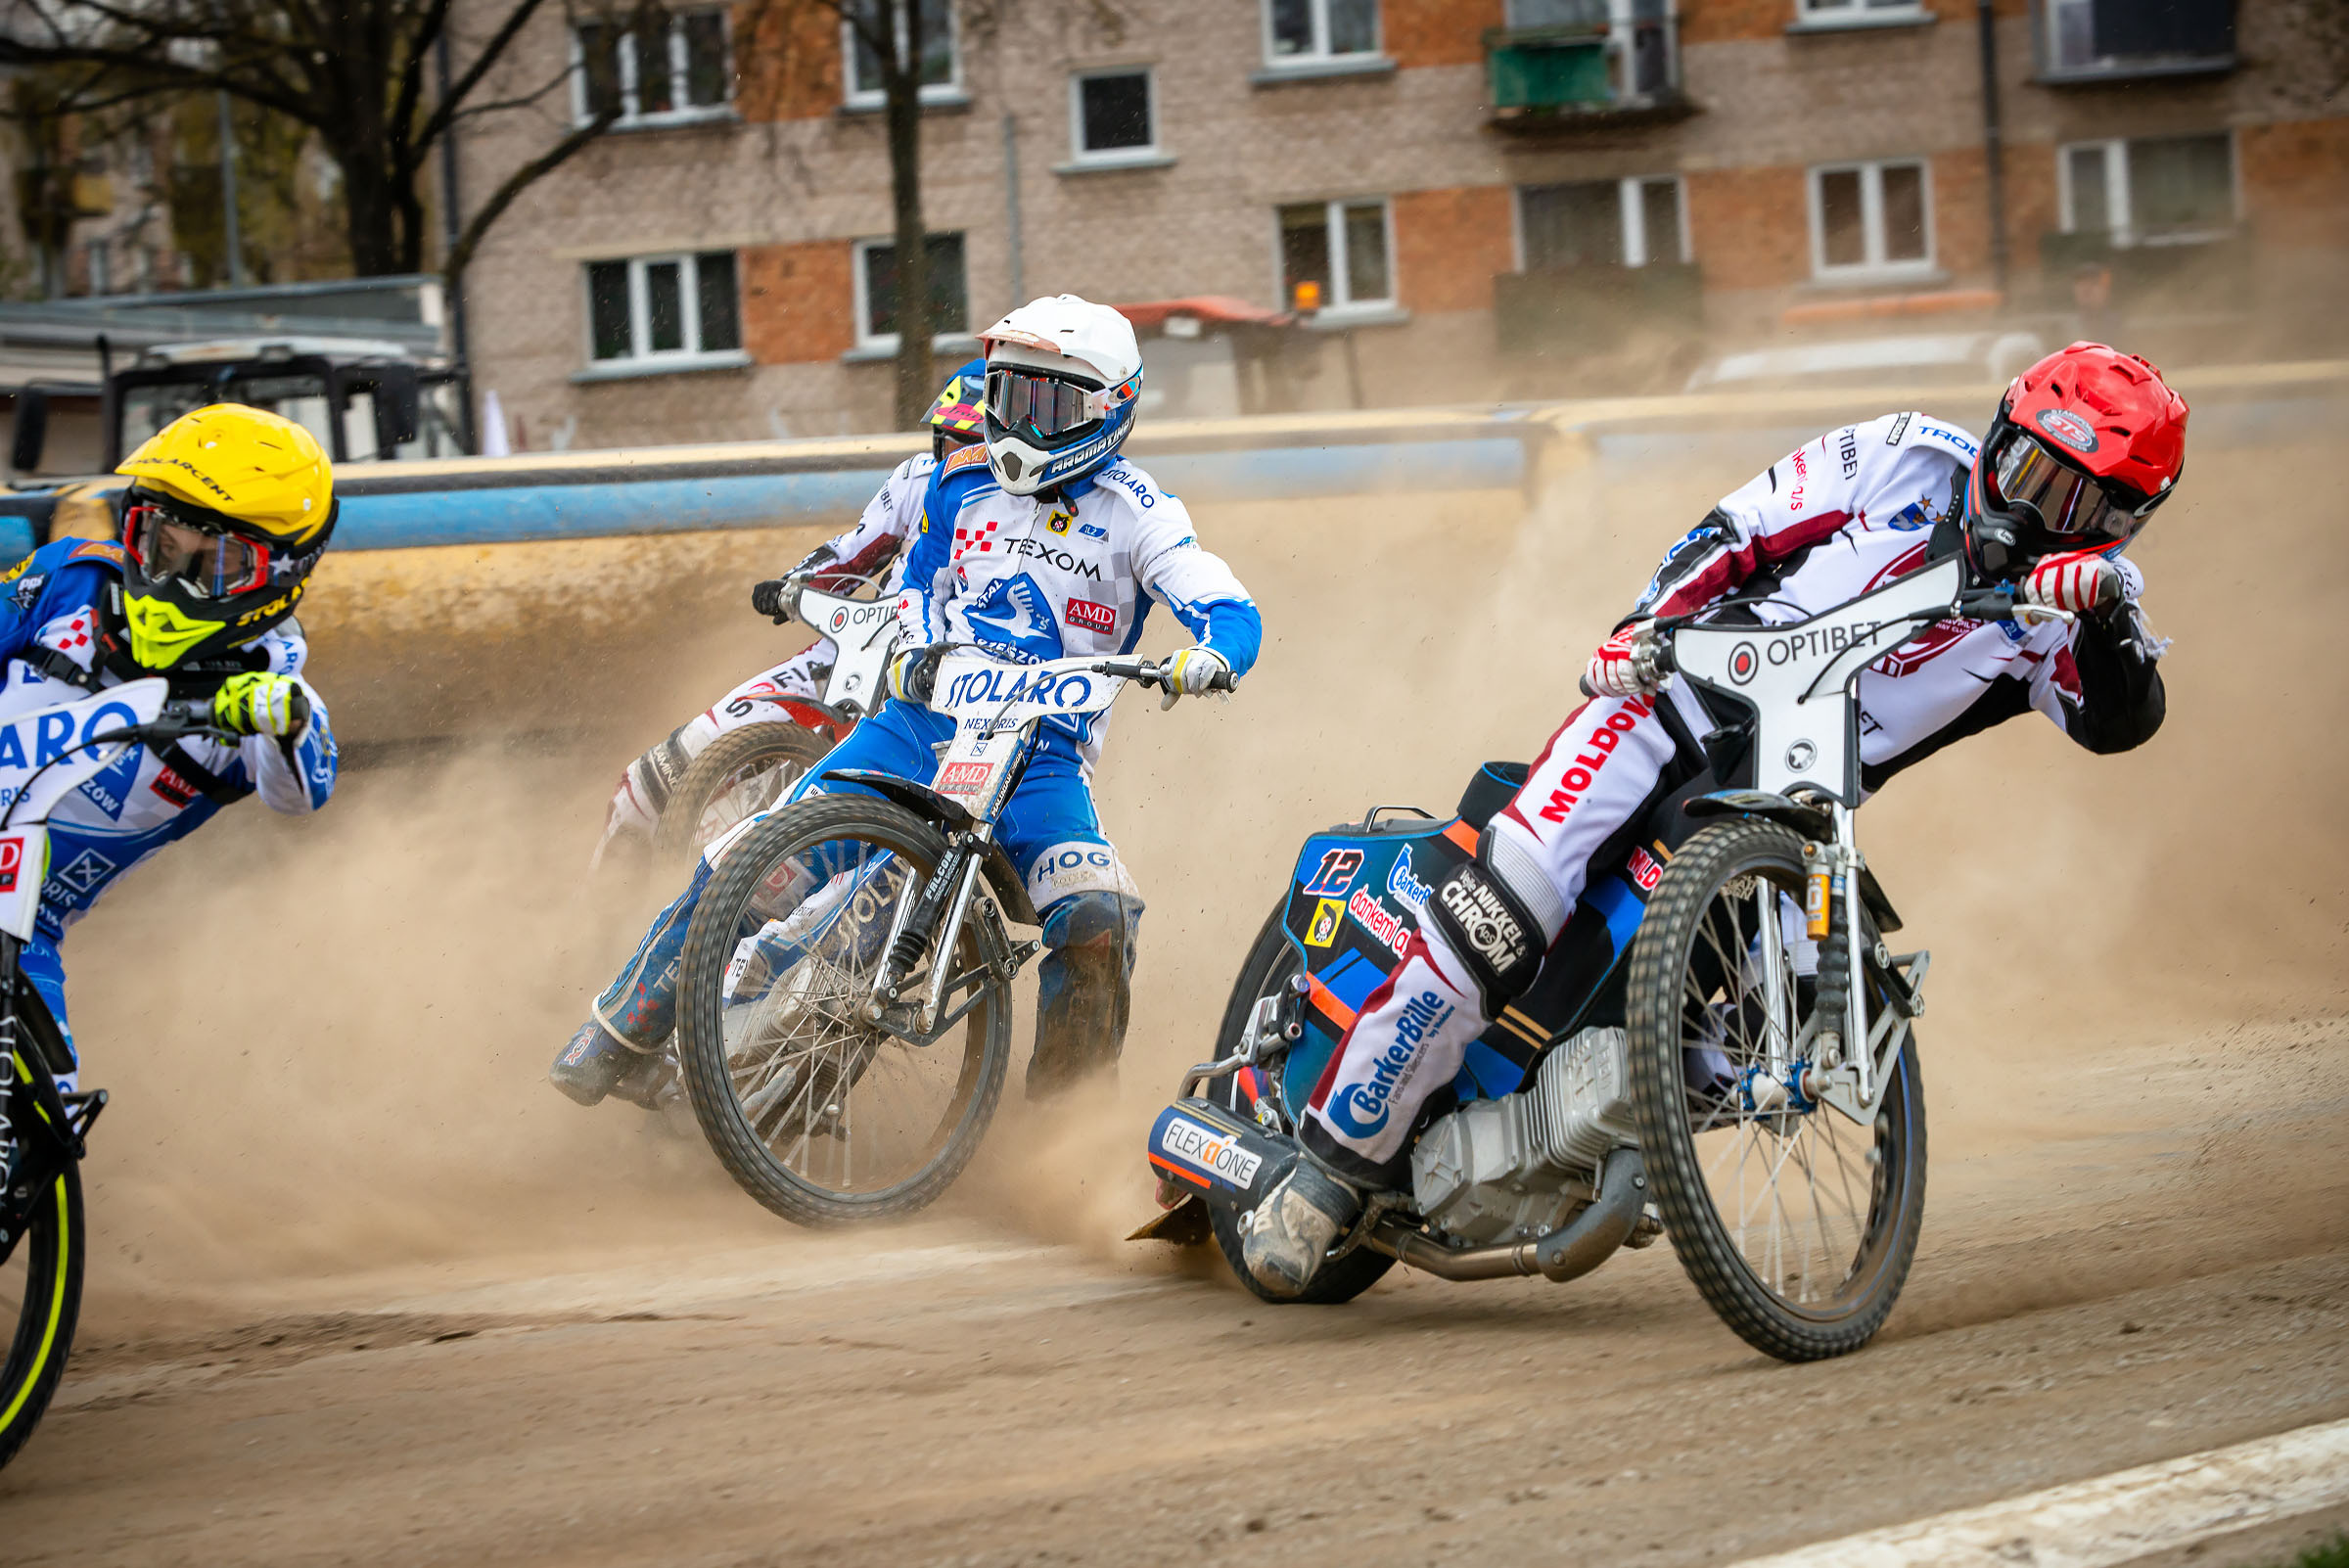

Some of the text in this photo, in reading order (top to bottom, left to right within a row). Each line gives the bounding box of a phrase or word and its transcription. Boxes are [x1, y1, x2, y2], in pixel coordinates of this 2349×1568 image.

[2049, 414, 2089, 442] STS
[1102, 469, 1155, 508] STOLARO
[1004, 538, 1102, 581] TEXOM
[978, 579, 1003, 610] STAL
[1069, 601, 1114, 624] AMD
[1069, 616, 1110, 631] GROUP
[1768, 621, 1881, 666] OPTIBET
[944, 669, 1092, 709] STOLARO
[944, 764, 989, 783] AMD
[925, 850, 954, 900] FALCON
[1037, 851, 1111, 883] HOG
[1303, 849, 1365, 897] 12
[1351, 885, 1402, 943] dankemi
[1442, 880, 1517, 973] CHROM
[1473, 884, 1522, 947] NIKKEL
[1515, 945, 1526, 957] &
[1353, 991, 1446, 1116] BarkerBille
